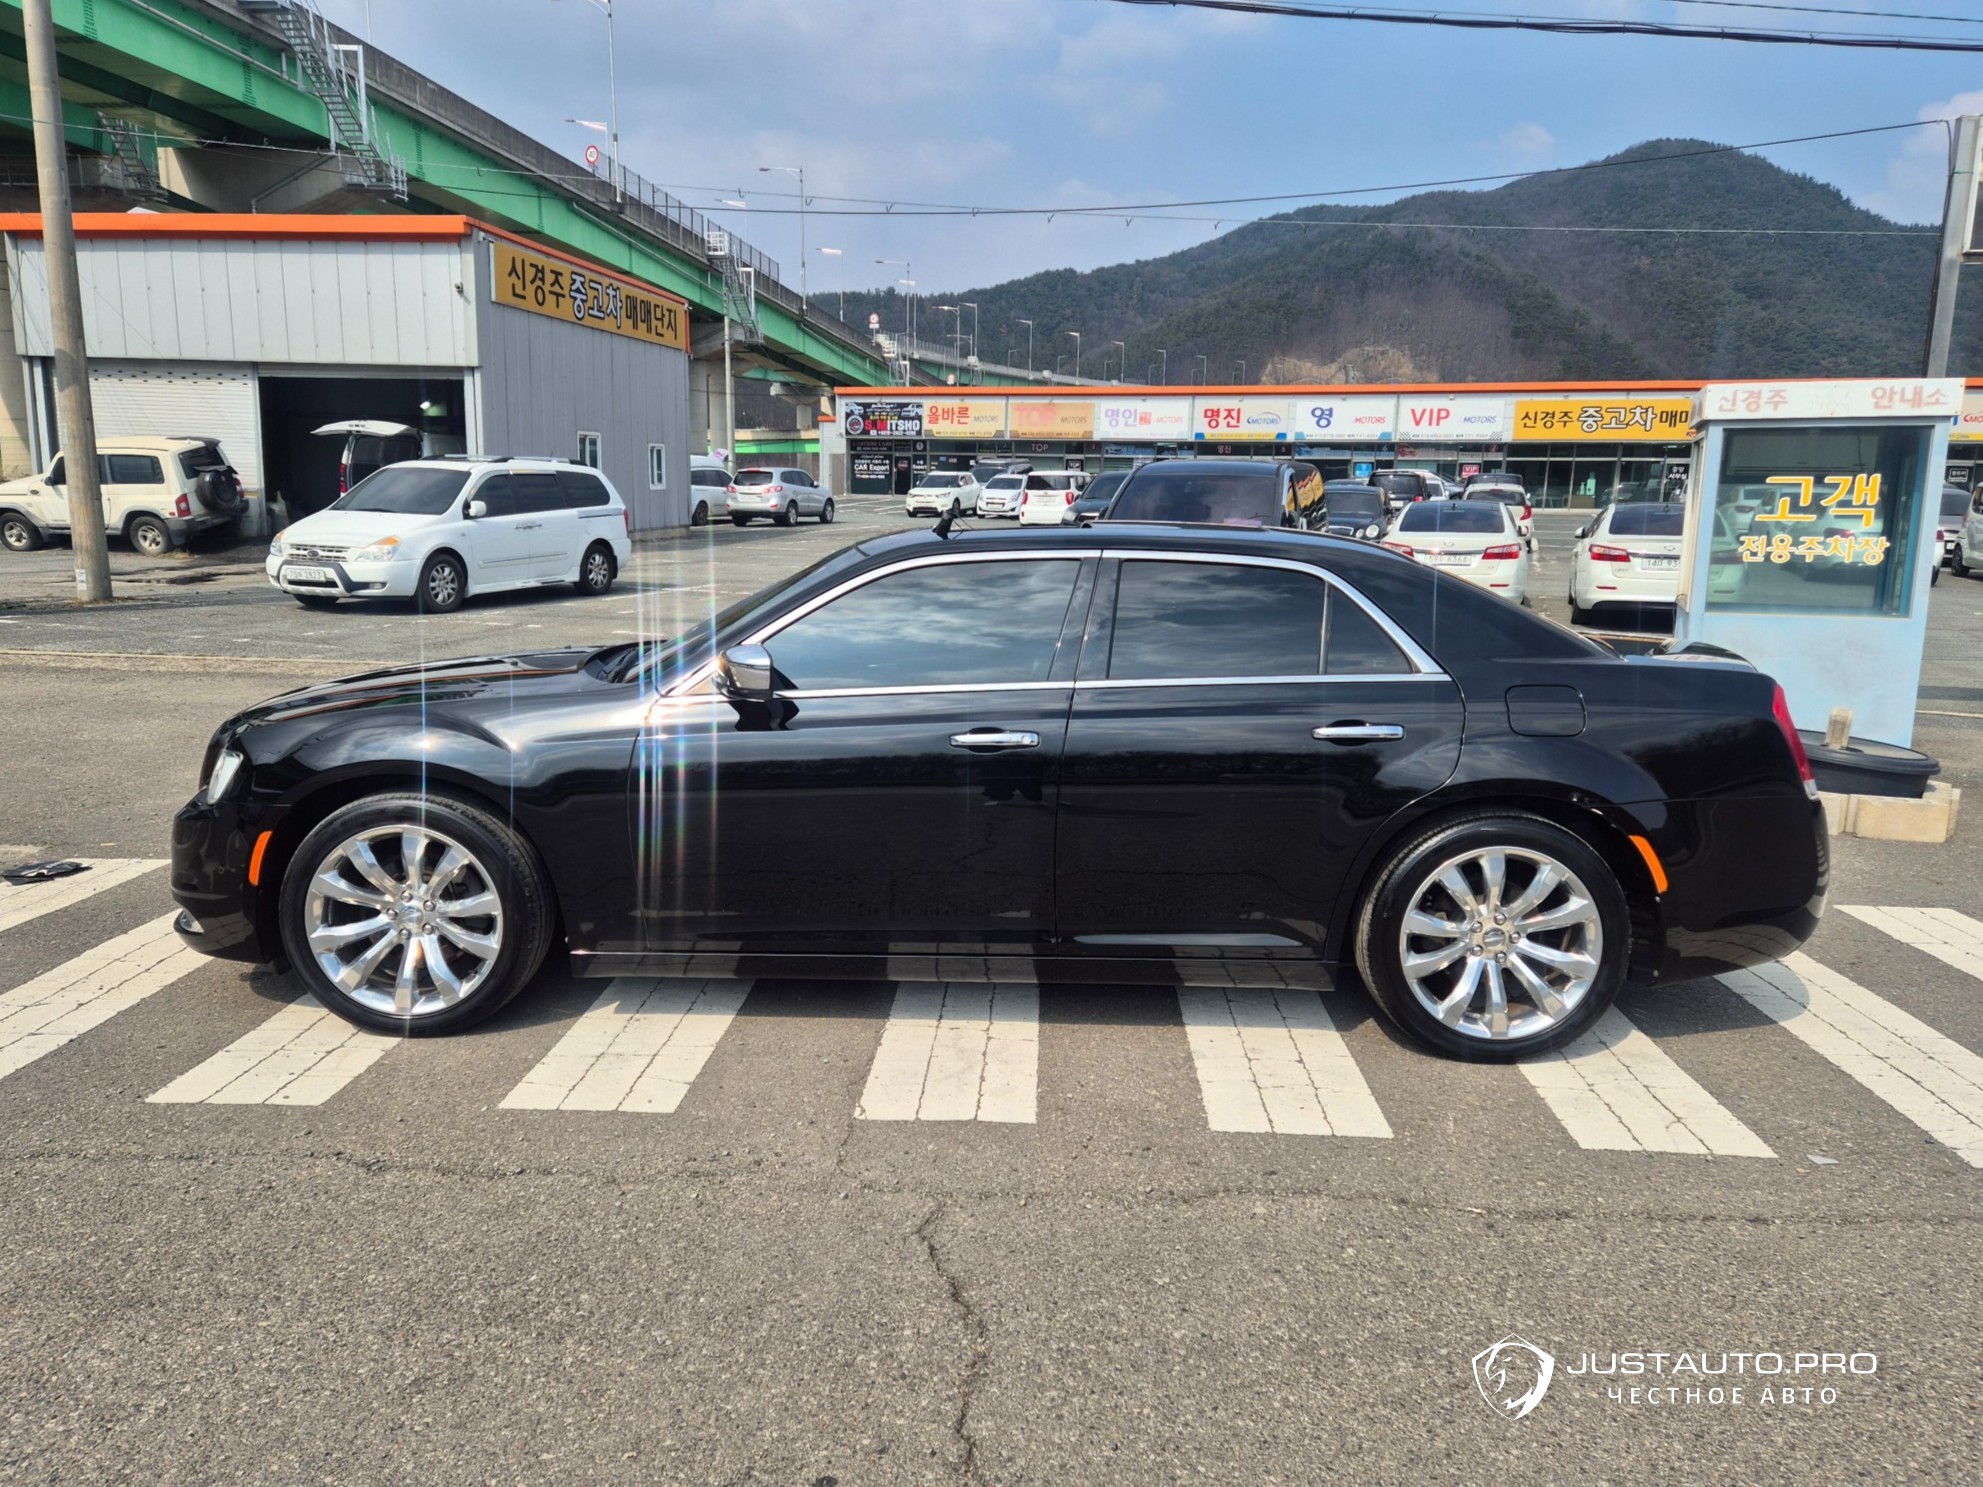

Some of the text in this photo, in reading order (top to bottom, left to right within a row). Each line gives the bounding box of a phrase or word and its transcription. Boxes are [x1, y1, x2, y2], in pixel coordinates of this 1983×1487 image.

[507, 256, 678, 341] 신경주 중고차 매매단지
[1718, 388, 1789, 412] 신경주
[1871, 385, 1950, 409] 안내소
[927, 405, 999, 425] 올바른 MOTORS
[1015, 406, 1088, 428] TOP MOTORS
[1104, 408, 1138, 428] 명인
[1156, 416, 1184, 424] MOTORS
[1203, 407, 1279, 429] 명진 MOTORS
[1311, 406, 1387, 428] 영 MOTORS
[1410, 407, 1497, 427] VIP MOTORS
[1521, 411, 1575, 429] 신경주
[1577, 406, 1658, 433] 중고차
[1031, 443, 1049, 451] TOP
[869, 464, 890, 472] Export
[1755, 473, 1882, 528] 고객
[1738, 534, 1891, 566] 전용주차장
